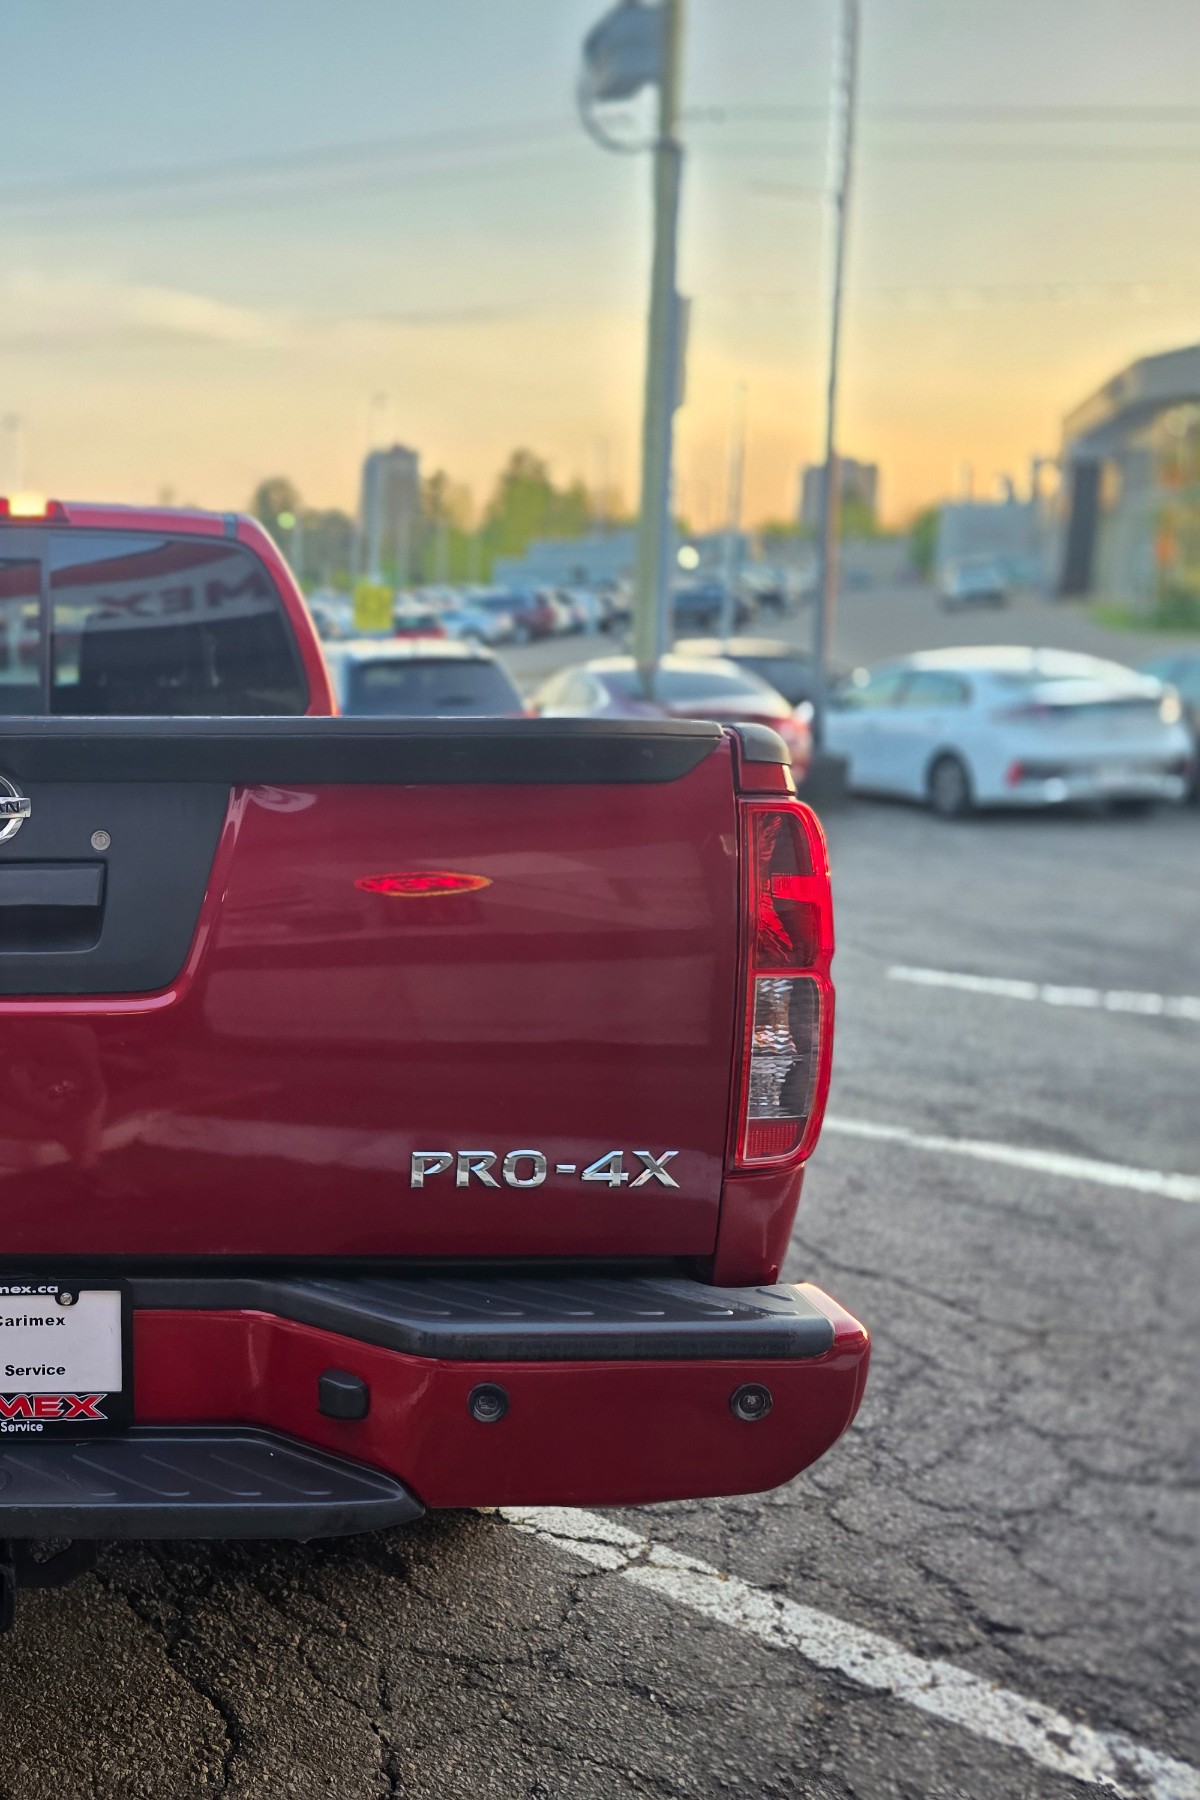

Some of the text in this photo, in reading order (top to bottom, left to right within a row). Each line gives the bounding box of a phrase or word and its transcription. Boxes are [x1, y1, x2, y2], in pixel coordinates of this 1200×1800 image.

[410, 1149, 681, 1189] PRO-4X
[4, 1364, 66, 1377] Service
[0, 1421, 44, 1433] Service
